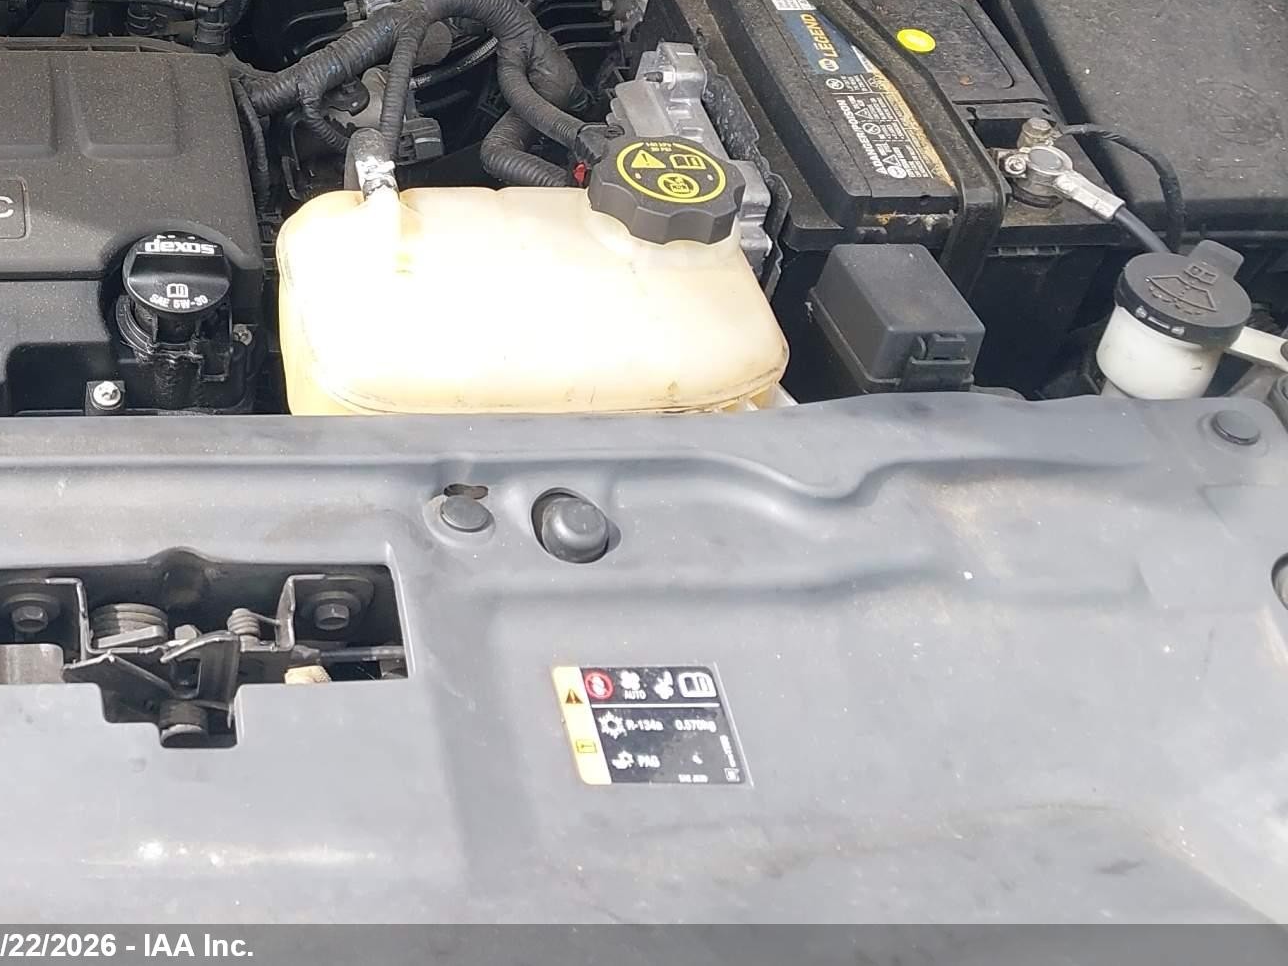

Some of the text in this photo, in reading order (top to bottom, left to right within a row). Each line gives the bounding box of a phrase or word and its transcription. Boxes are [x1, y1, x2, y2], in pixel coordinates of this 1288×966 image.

[799, 14, 839, 58] LEGEND
[149, 293, 209, 309] SAE 5W-30
[624, 689, 647, 700] AUTO
